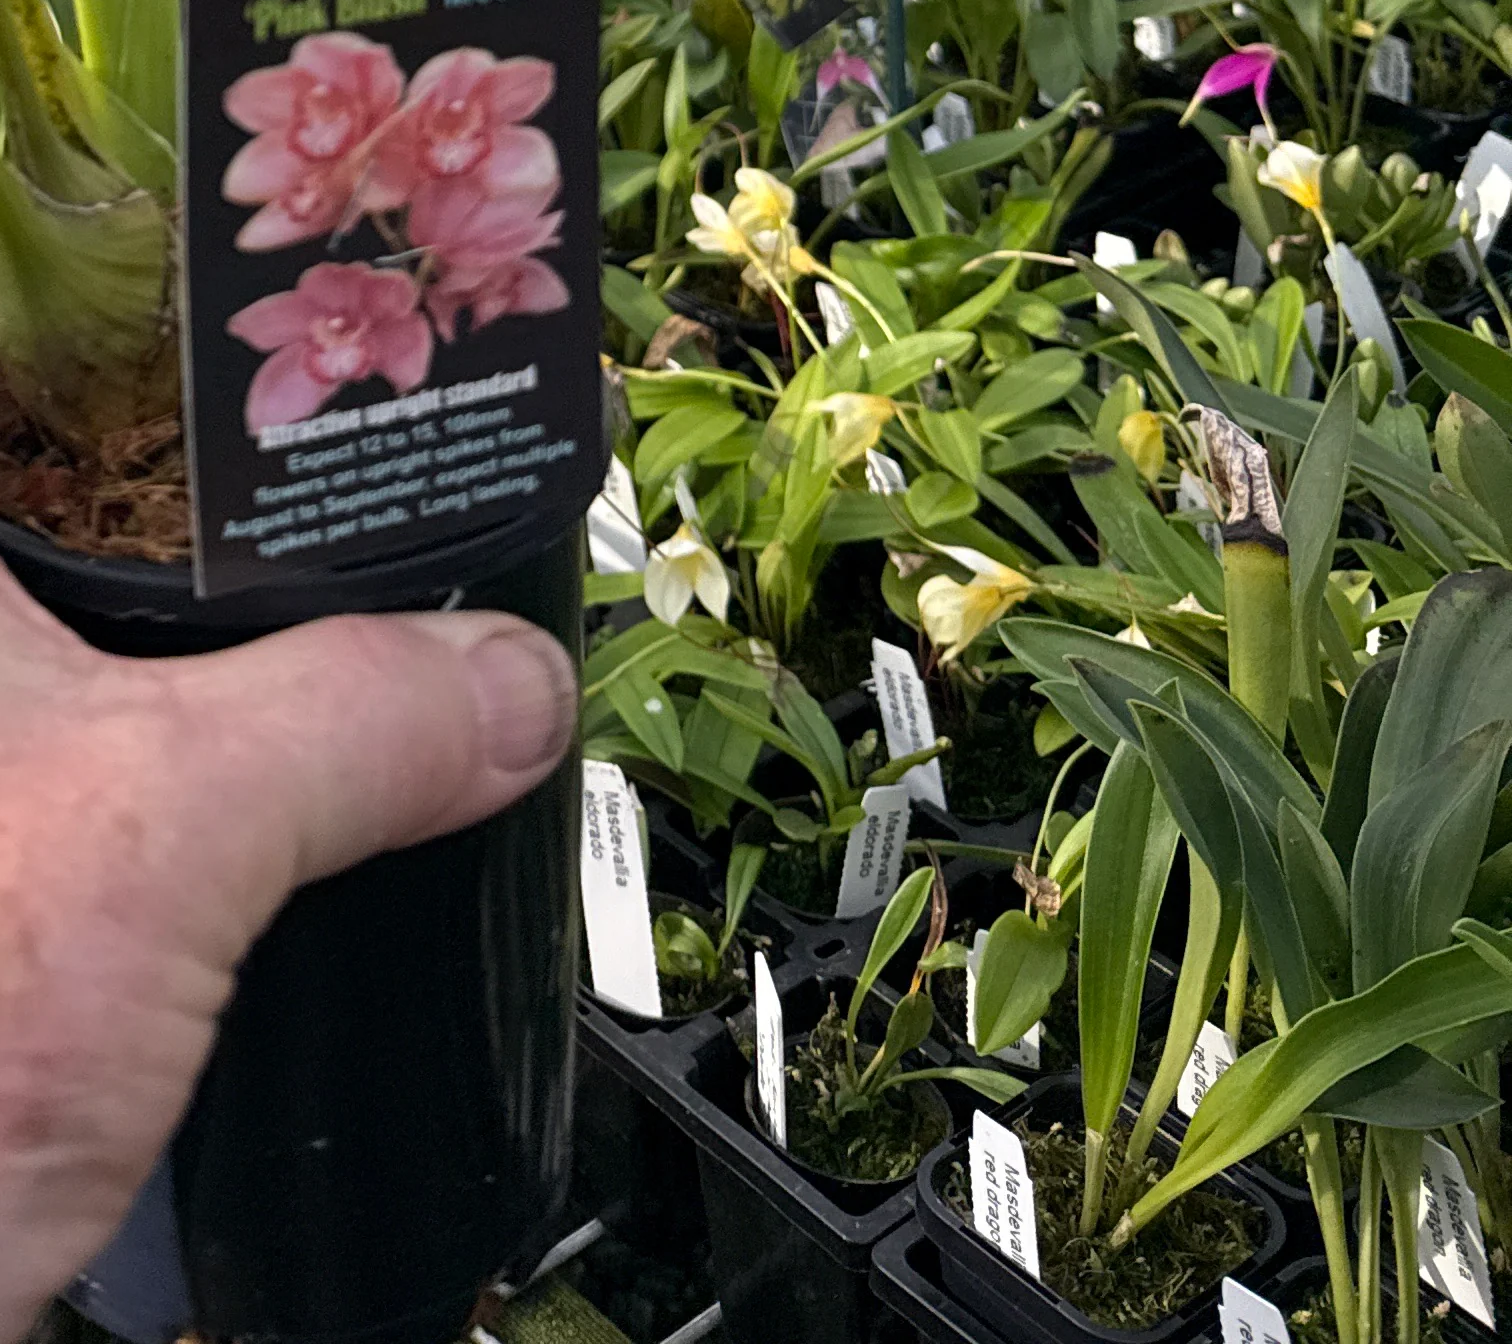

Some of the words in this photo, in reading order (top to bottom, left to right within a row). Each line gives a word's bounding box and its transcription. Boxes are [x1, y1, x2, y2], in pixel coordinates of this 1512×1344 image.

[258, 408, 362, 452] Attractive
[364, 386, 441, 427] upright
[442, 363, 538, 409] standard
[253, 476, 329, 506] flowers
[330, 468, 358, 488] on
[360, 450, 433, 484] upright
[434, 435, 496, 464] spikes
[497, 423, 546, 446] from
[286, 441, 358, 474] Expect
[360, 433, 384, 455] 12
[386, 430, 409, 450] to
[221, 509, 294, 541] August
[296, 502, 321, 520] to
[433, 459, 497, 488] expect
[499, 438, 577, 469] multiple
[256, 527, 323, 558] spikes
[324, 518, 360, 543] per
[418, 491, 471, 518] Long
[584, 790, 605, 861] eldorado
[603, 791, 631, 888] Masdevallia
[859, 814, 882, 879] eldorado
[874, 810, 901, 897] Masdevallia
[983, 1149, 1000, 1189] red
[1425, 1193, 1447, 1257] dragon
[1442, 1173, 1474, 1282] Masdevallia
[1237, 1318, 1253, 1344] re
